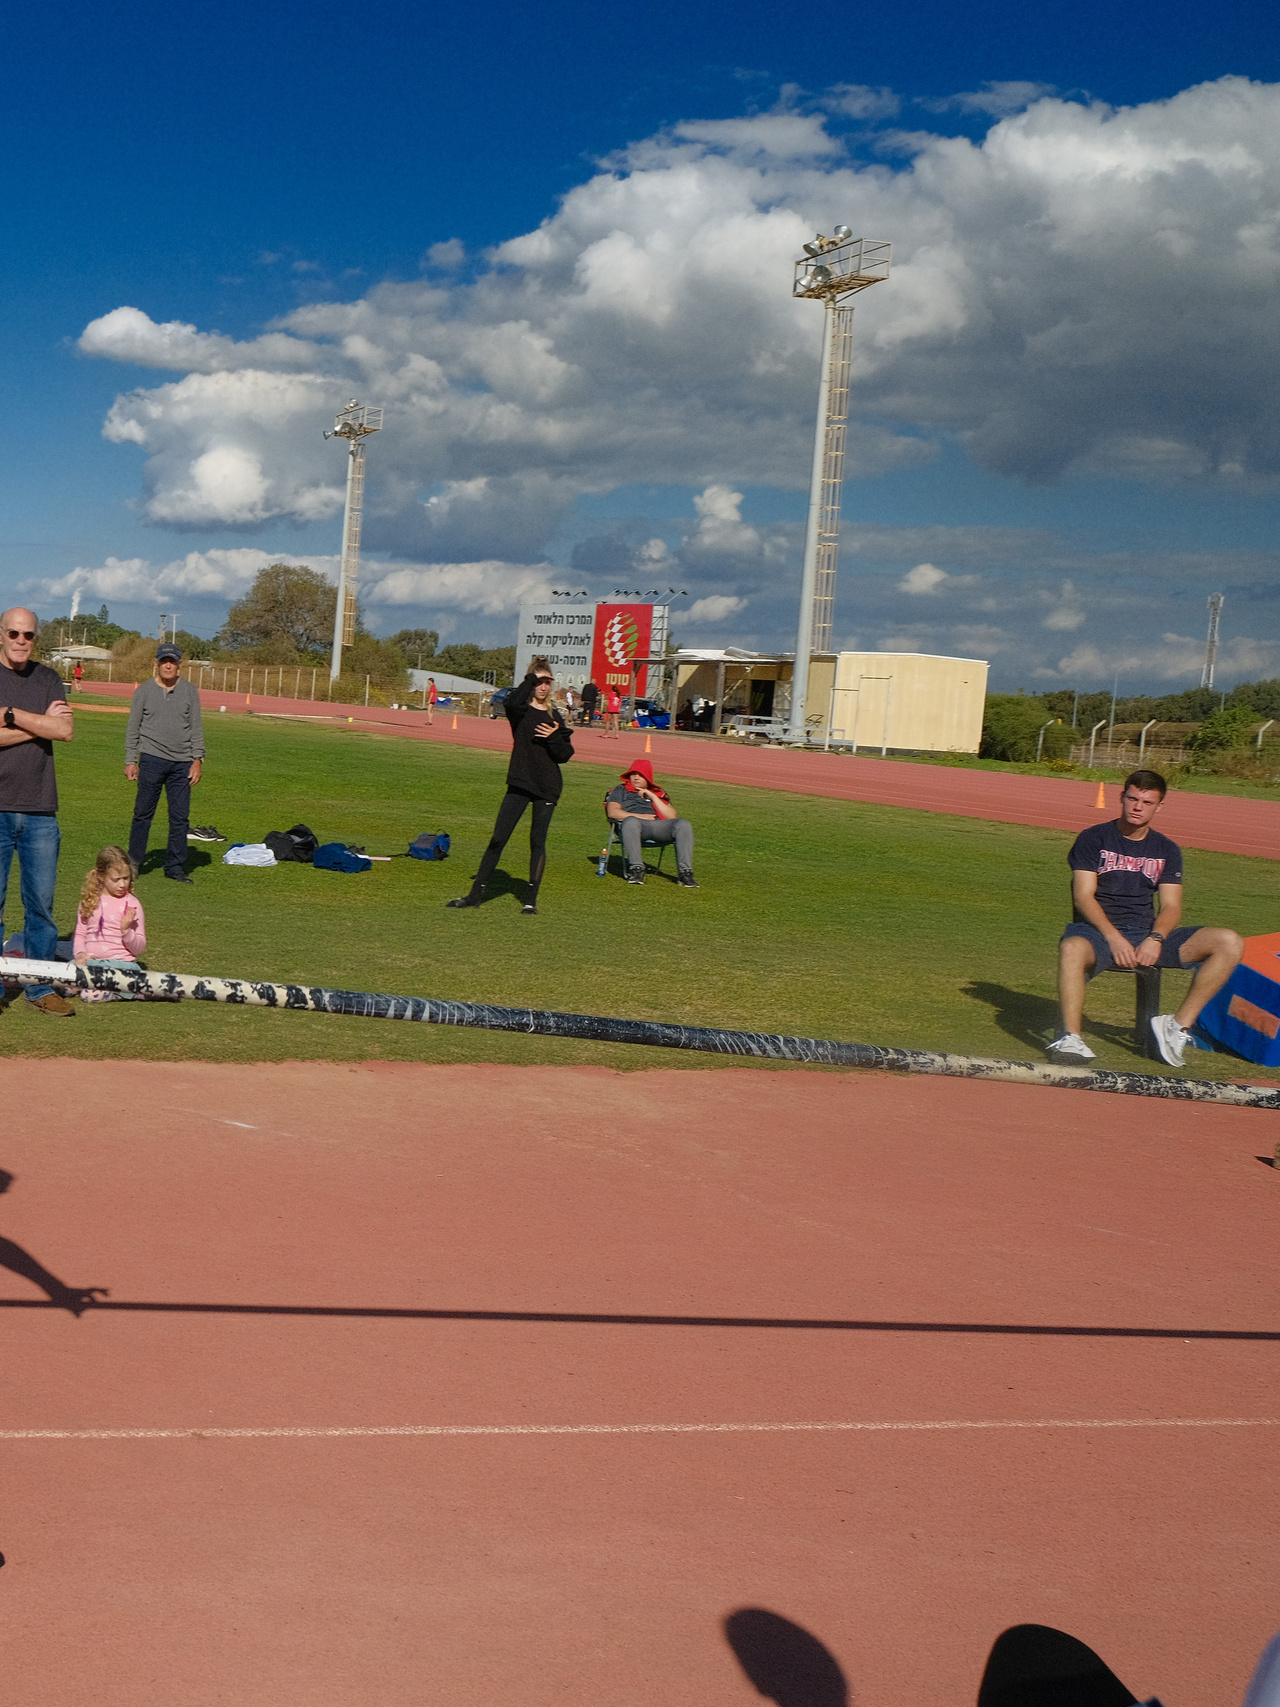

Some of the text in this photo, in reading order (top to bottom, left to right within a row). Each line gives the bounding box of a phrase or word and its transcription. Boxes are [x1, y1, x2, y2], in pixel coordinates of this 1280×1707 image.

[534, 612, 592, 624] המרכז הלאומי
[526, 632, 591, 647] לאתלטיקה קלה
[606, 673, 630, 685] טוטו
[1096, 849, 1166, 886] CHAMPION
